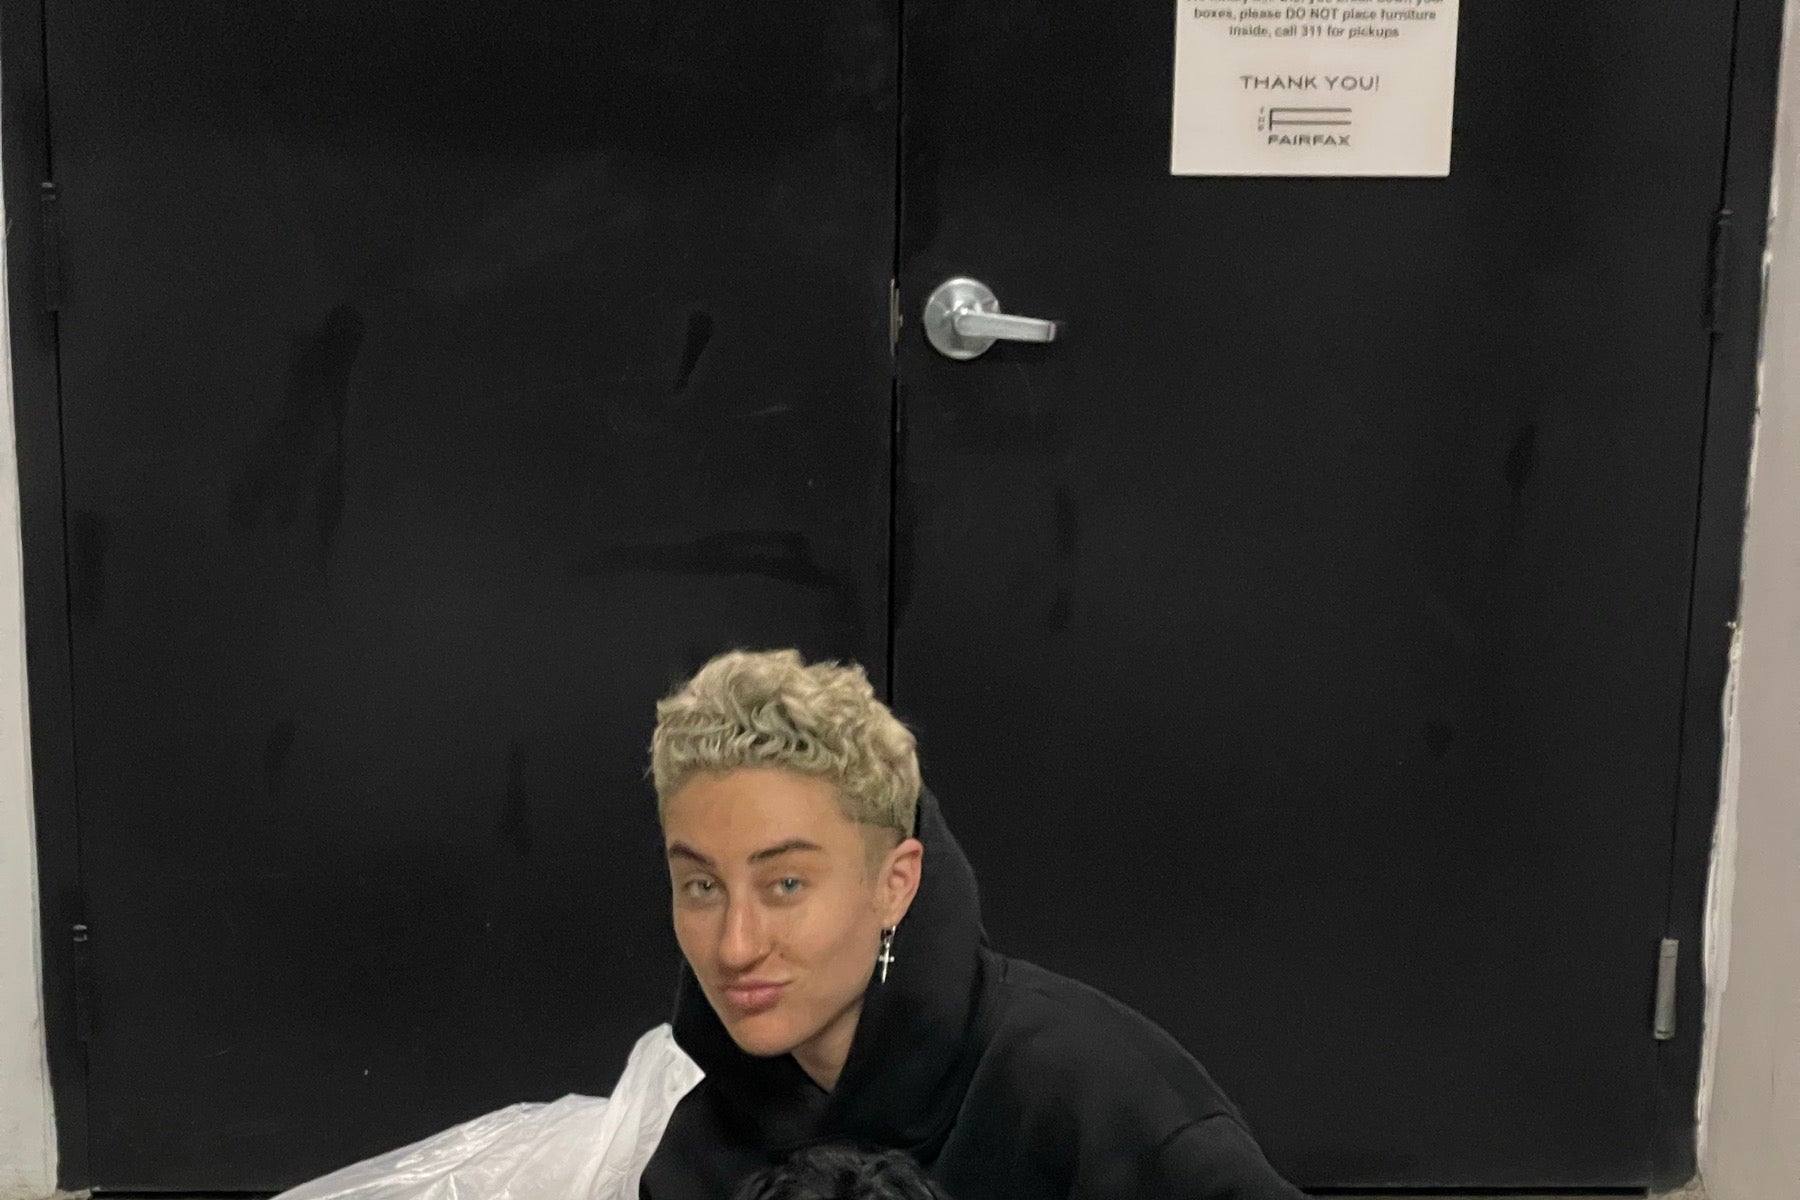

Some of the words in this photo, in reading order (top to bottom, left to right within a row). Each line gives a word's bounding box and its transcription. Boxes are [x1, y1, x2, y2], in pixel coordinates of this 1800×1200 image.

[1194, 7, 1236, 20] boxes,
[1239, 8, 1282, 21] please
[1286, 7, 1306, 19] DO
[1310, 7, 1338, 19] NOT
[1342, 8, 1377, 22] place
[1380, 9, 1437, 20] furniture
[1274, 26, 1297, 37] call
[1301, 25, 1322, 37] 311
[1327, 25, 1345, 36] for
[1348, 25, 1400, 39] pickups
[1240, 75, 1318, 90] THANK
[1324, 75, 1380, 92] YOU!
[1267, 134, 1351, 146] FAIRFAX
